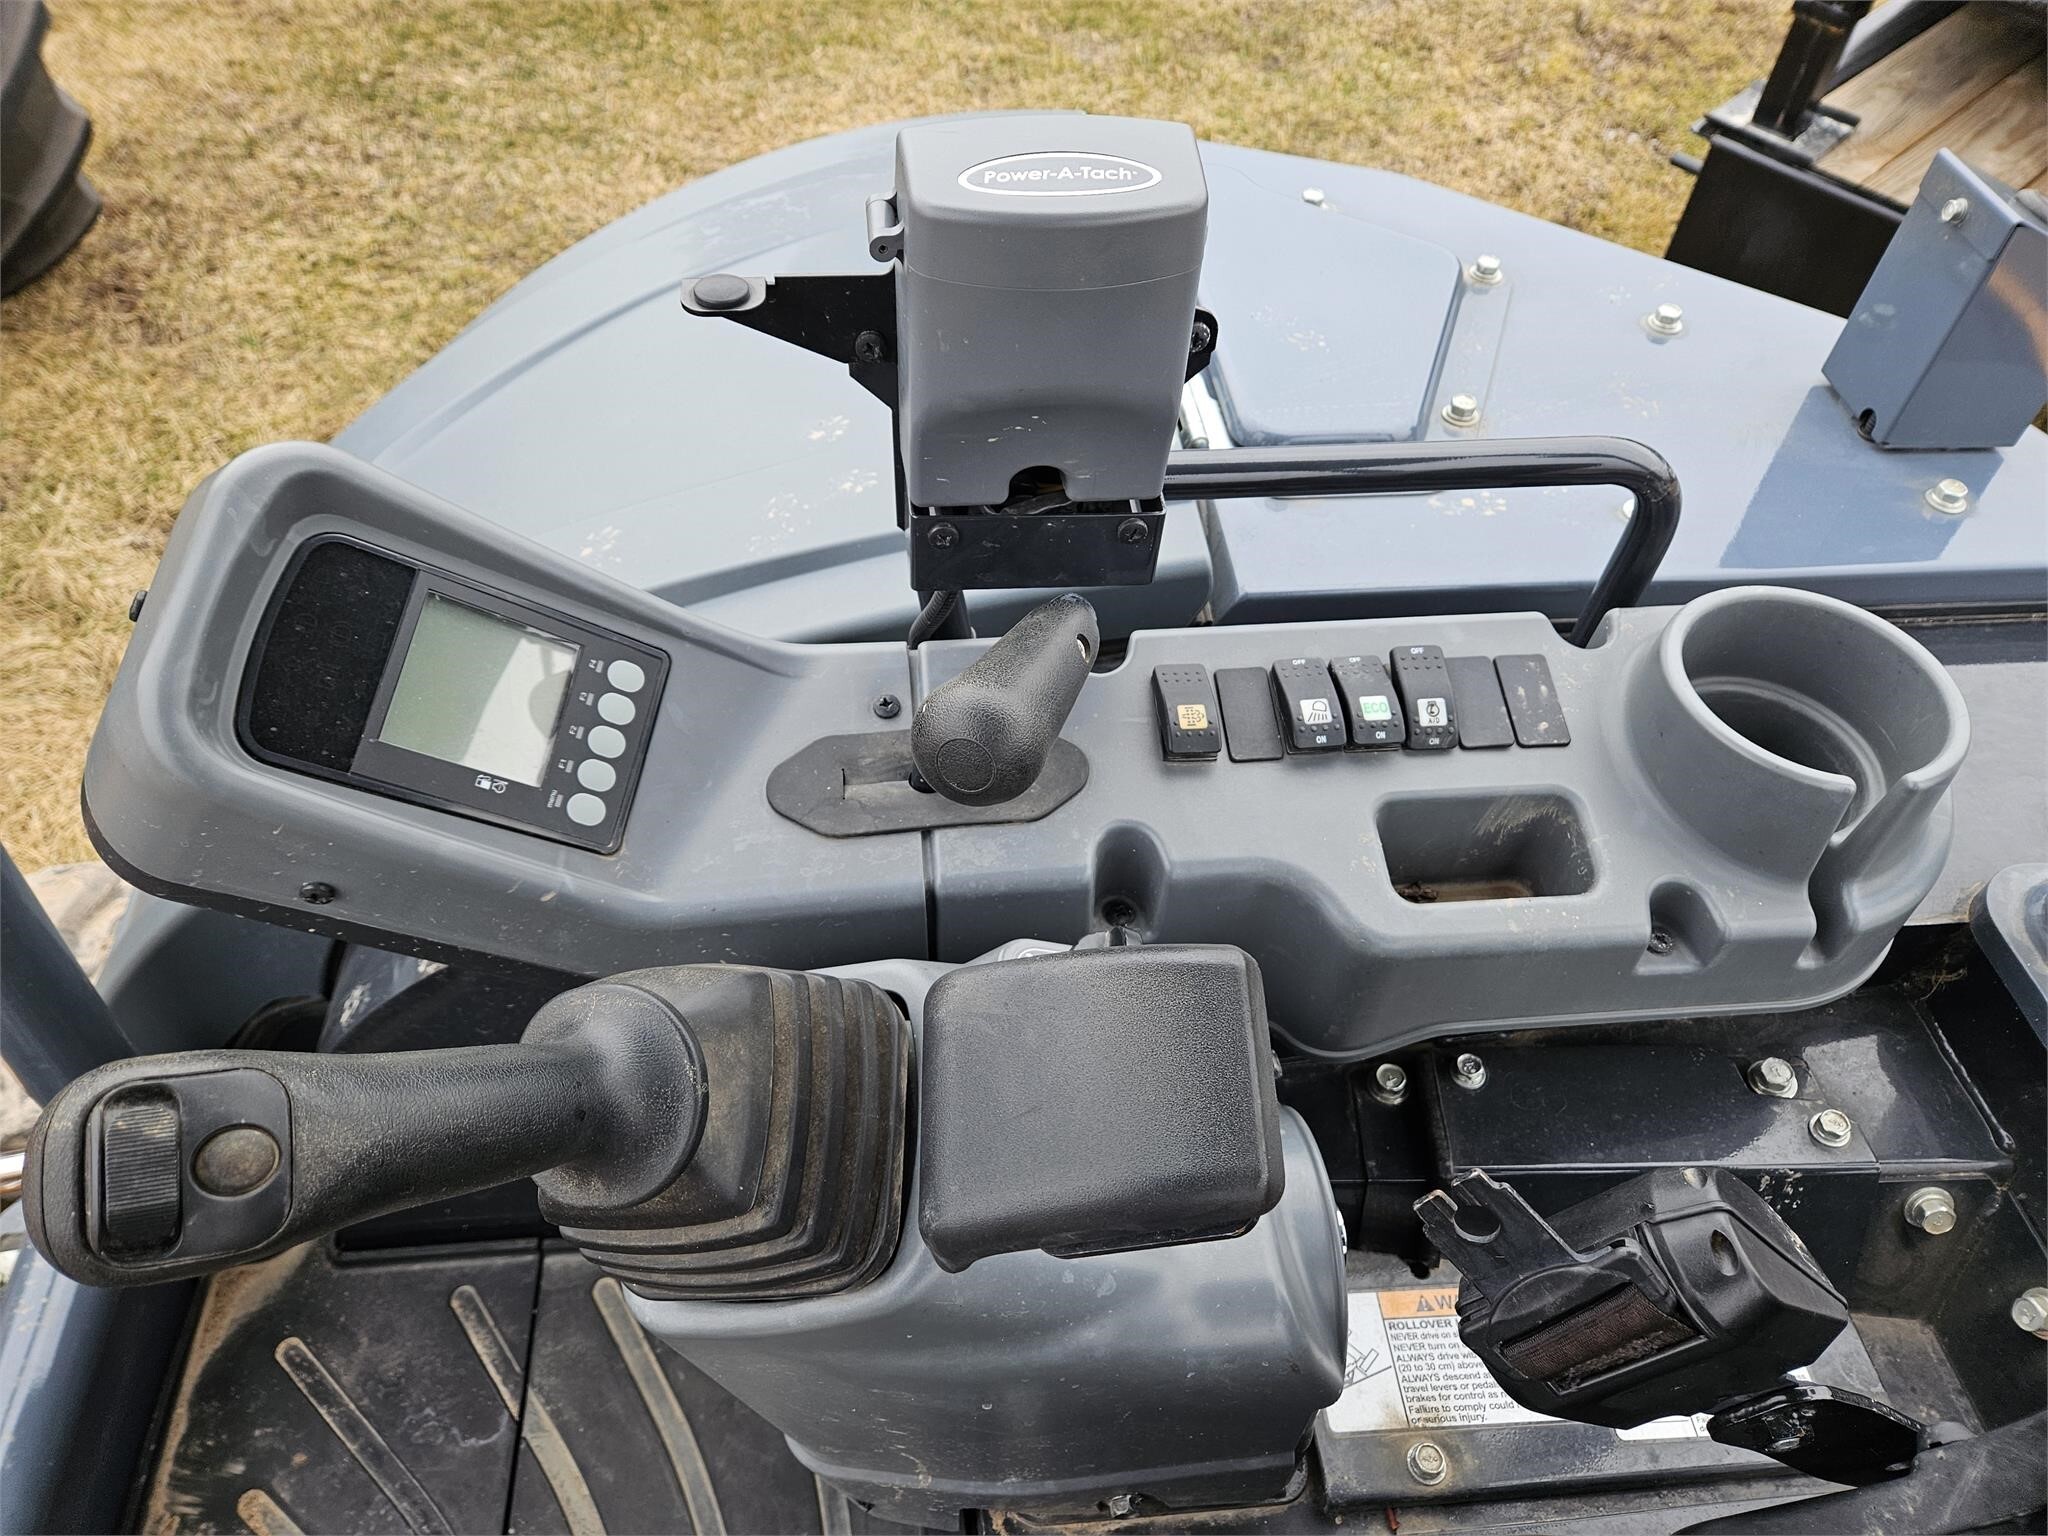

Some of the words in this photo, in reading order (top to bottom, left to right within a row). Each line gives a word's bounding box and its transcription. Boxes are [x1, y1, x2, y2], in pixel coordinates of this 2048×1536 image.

[983, 165, 1136, 184] Power-A-Tach
[1410, 646, 1424, 655] OFF
[588, 659, 597, 670] F4
[1292, 658, 1306, 666] OFF
[1349, 656, 1361, 664] OFF
[579, 691, 588, 702] F3
[1363, 701, 1388, 714] ECO
[568, 725, 578, 736] F2
[1376, 731, 1387, 740] ON
[1315, 735, 1327, 744] ON
[1428, 737, 1440, 745] ON
[558, 758, 568, 770] F1
[546, 789, 559, 809] menu
[1388, 1319, 1452, 1331] ROLLOVER
[1389, 1331, 1419, 1342] NEVER
[1420, 1331, 1439, 1340] drive
[1393, 1341, 1426, 1352] NEVER
[1428, 1342, 1446, 1351] turn
[1448, 1342, 1460, 1350] on
[1396, 1352, 1435, 1363] ALWAYS
[1437, 1350, 1459, 1361] drive
[1398, 1362, 1412, 1374] (20
[1414, 1363, 1423, 1372] to
[1425, 1362, 1436, 1372] 30
[1438, 1361, 1455, 1372] cm)
[1401, 1372, 1440, 1384] ALWAYS
[1442, 1371, 1480, 1381] descend
[1403, 1383, 1428, 1393] travel
[1430, 1382, 1457, 1392] levers
[1460, 1383, 1469, 1391] or
[1405, 1393, 1436, 1404] brakes
[1438, 1392, 1451, 1402] for
[1453, 1391, 1485, 1401] control
[1488, 1390, 1498, 1399] as
[1408, 1403, 1440, 1414] Failure
[1442, 1403, 1451, 1413] to
[1453, 1401, 1486, 1413] comply
[1489, 1400, 1514, 1410] could
[1411, 1416, 1420, 1425] or
[1421, 1413, 1457, 1424] serious
